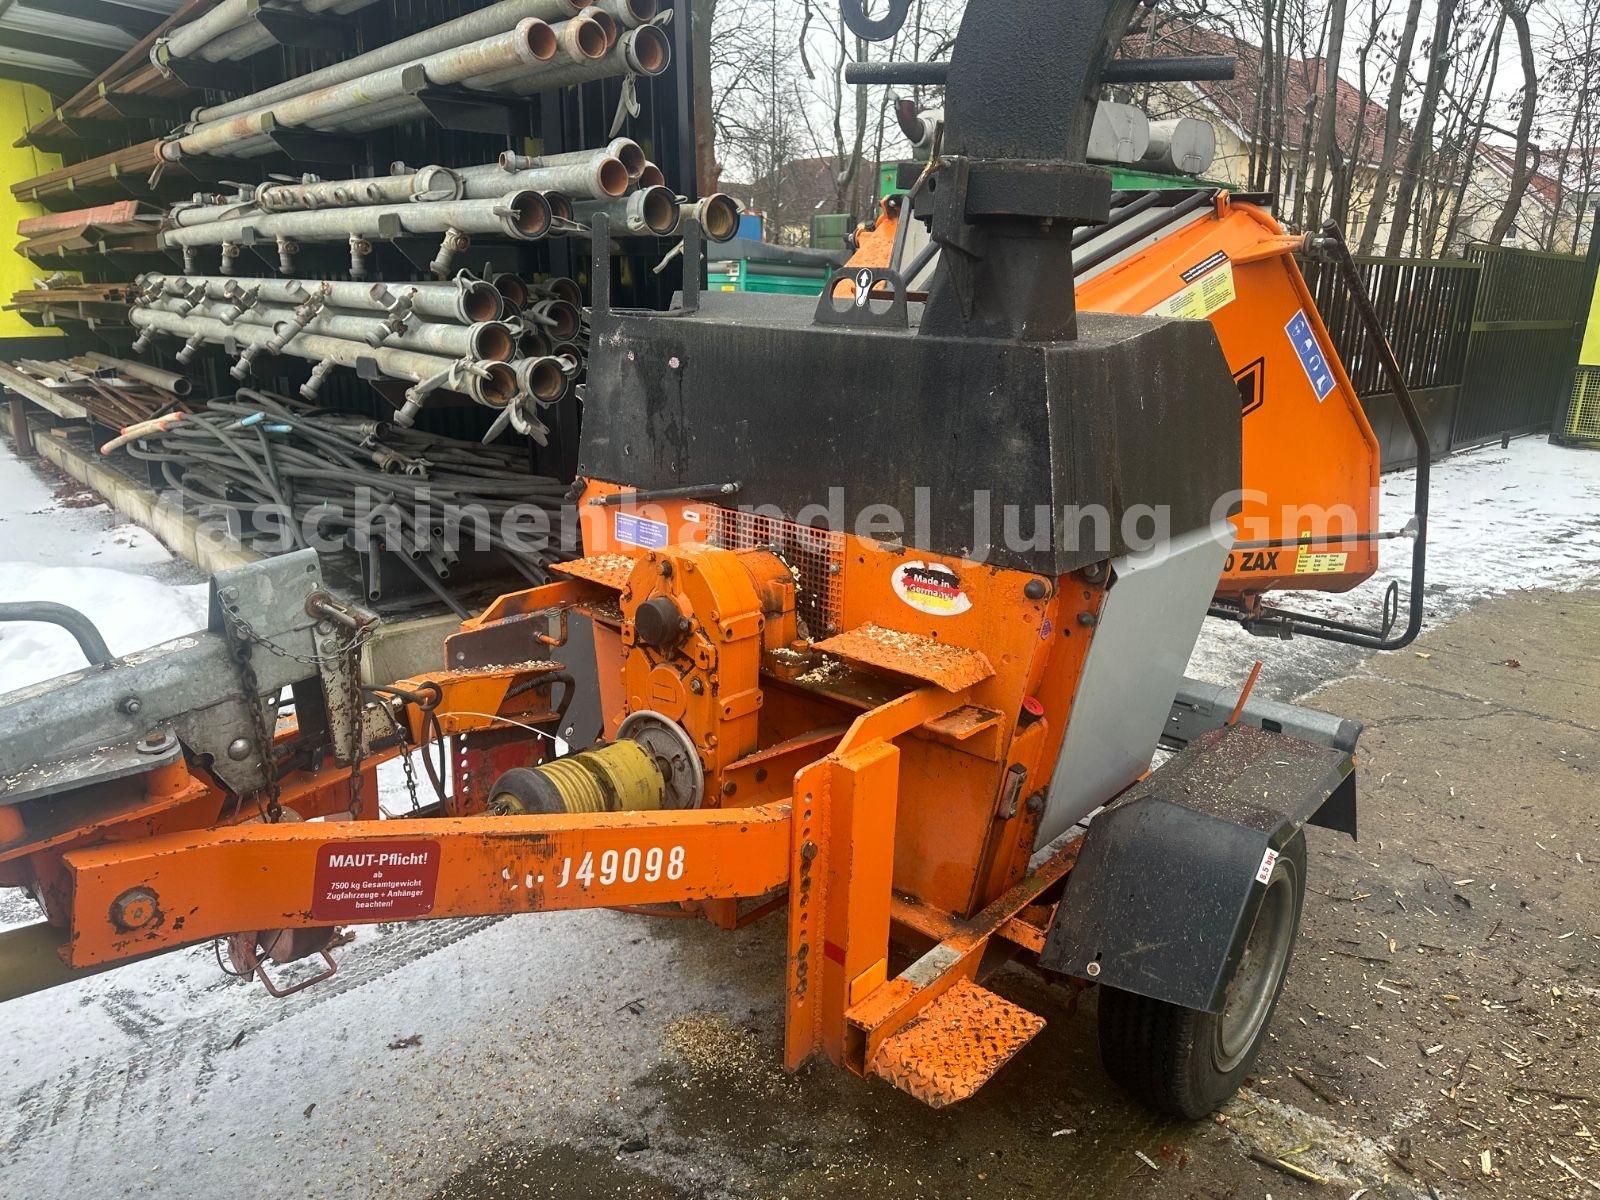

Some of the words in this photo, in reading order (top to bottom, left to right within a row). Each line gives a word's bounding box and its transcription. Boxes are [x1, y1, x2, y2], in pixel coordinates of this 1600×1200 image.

[1239, 552, 1279, 572] ZAX
[914, 574, 939, 586] Made
[941, 579, 950, 588] in
[329, 852, 428, 868] MAUT-Pflicht!
[1259, 867, 1269, 880] 8.5
[1265, 852, 1275, 865] bar
[373, 871, 383, 879] ab
[331, 882, 349, 890] 7500
[351, 882, 360, 890] kg
[362, 880, 422, 889] Gesamtgewicht
[326, 892, 379, 900] Zugfahrzeuge
[387, 889, 424, 898] Anhänger
[355, 900, 394, 909] beachten!
